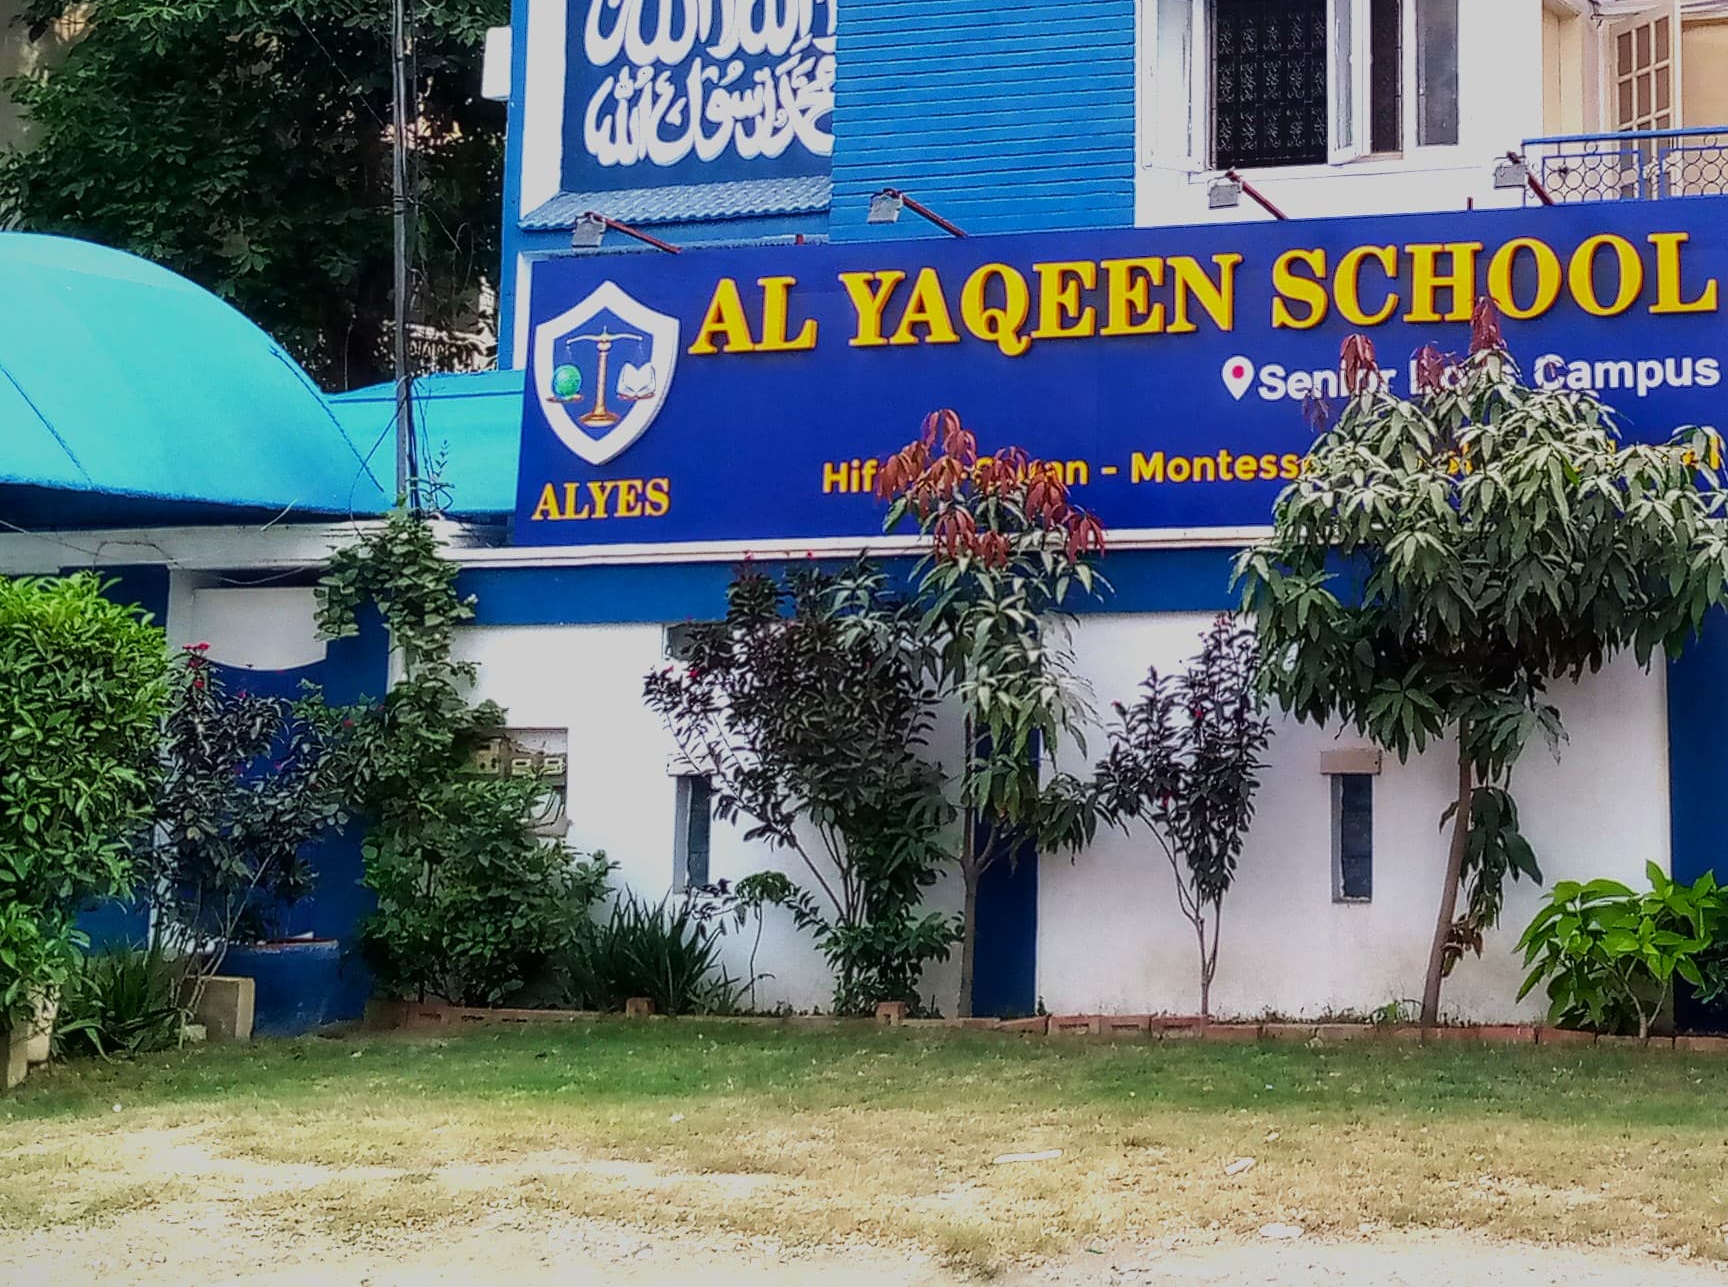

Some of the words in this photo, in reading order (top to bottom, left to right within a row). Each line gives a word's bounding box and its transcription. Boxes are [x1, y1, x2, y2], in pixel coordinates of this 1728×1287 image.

[687, 276, 819, 356] AL
[837, 250, 1243, 357] YAQEEN
[1271, 231, 1720, 330] SCHOOL
[1534, 354, 1721, 397] Campus
[533, 477, 671, 521] ALYES
